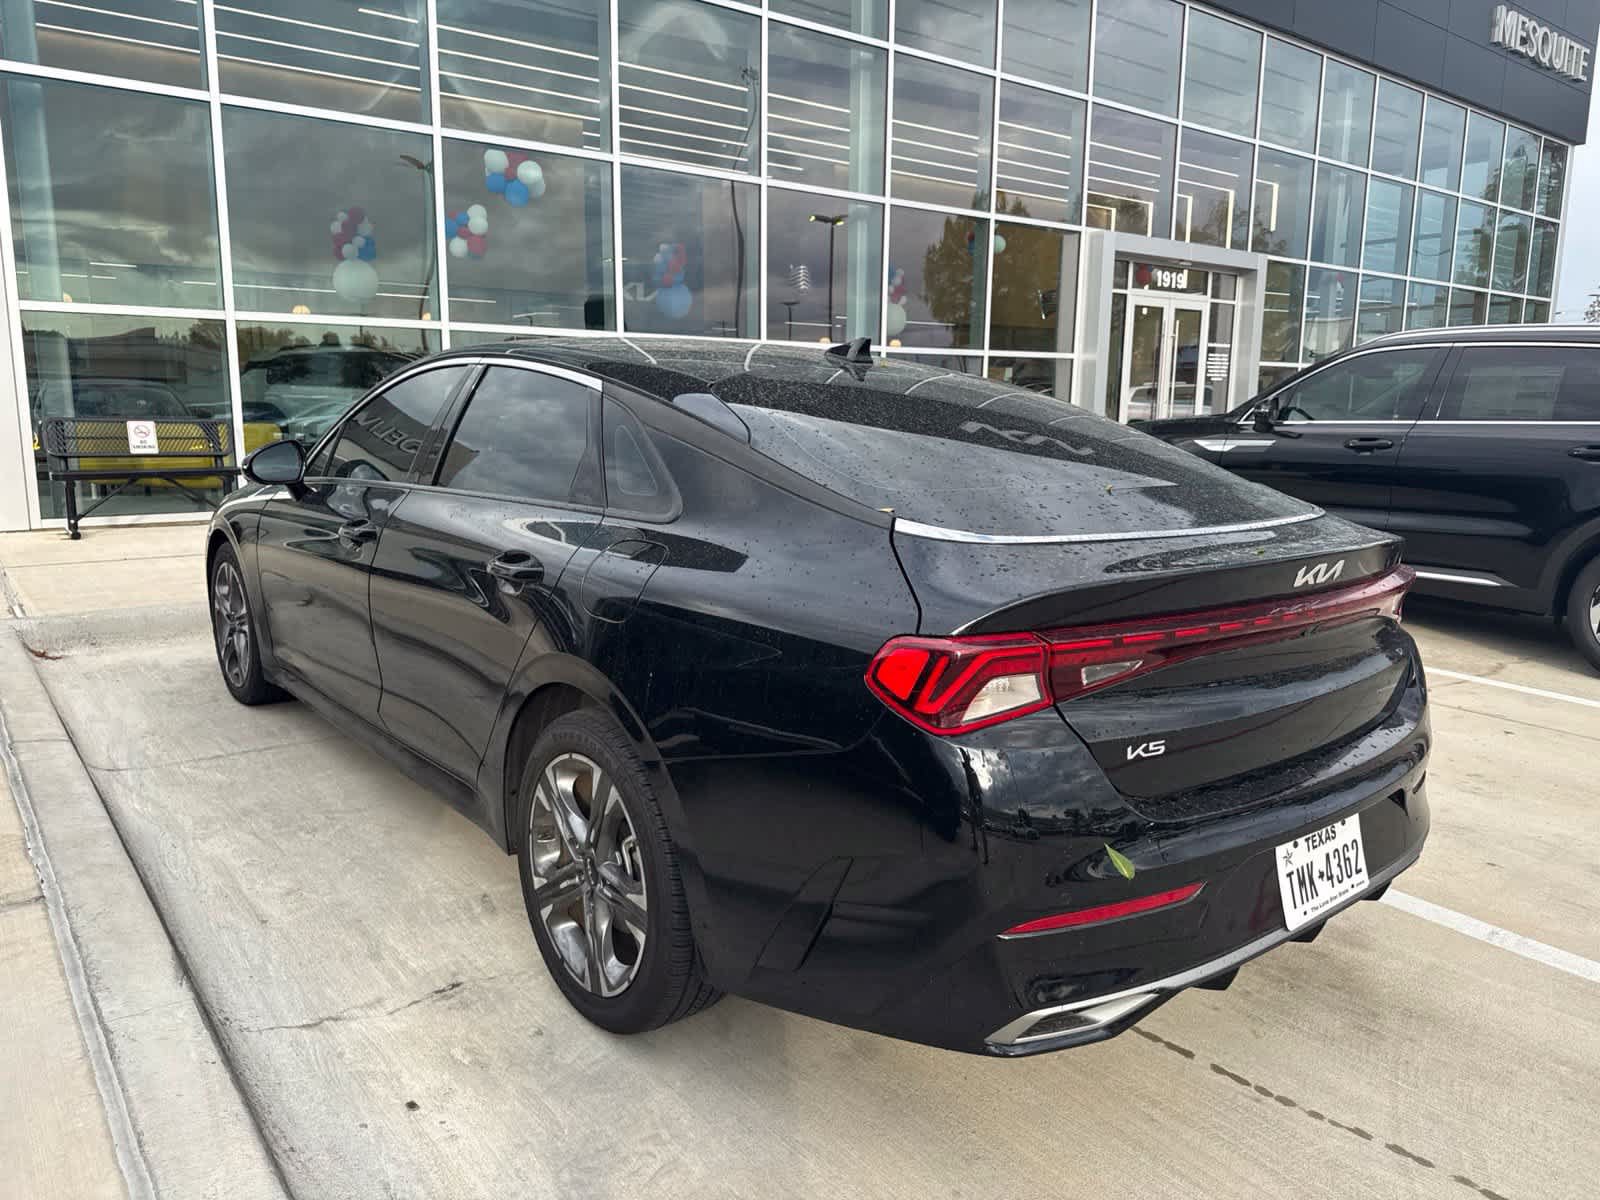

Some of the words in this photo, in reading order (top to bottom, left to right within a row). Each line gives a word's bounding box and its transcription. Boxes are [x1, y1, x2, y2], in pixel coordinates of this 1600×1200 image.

[1494, 4, 1590, 81] MESQUITE
[1157, 270, 1184, 289] 1919
[1293, 559, 1345, 588] KIA
[1127, 739, 1166, 761] K5
[1304, 825, 1337, 853] TEXAS
